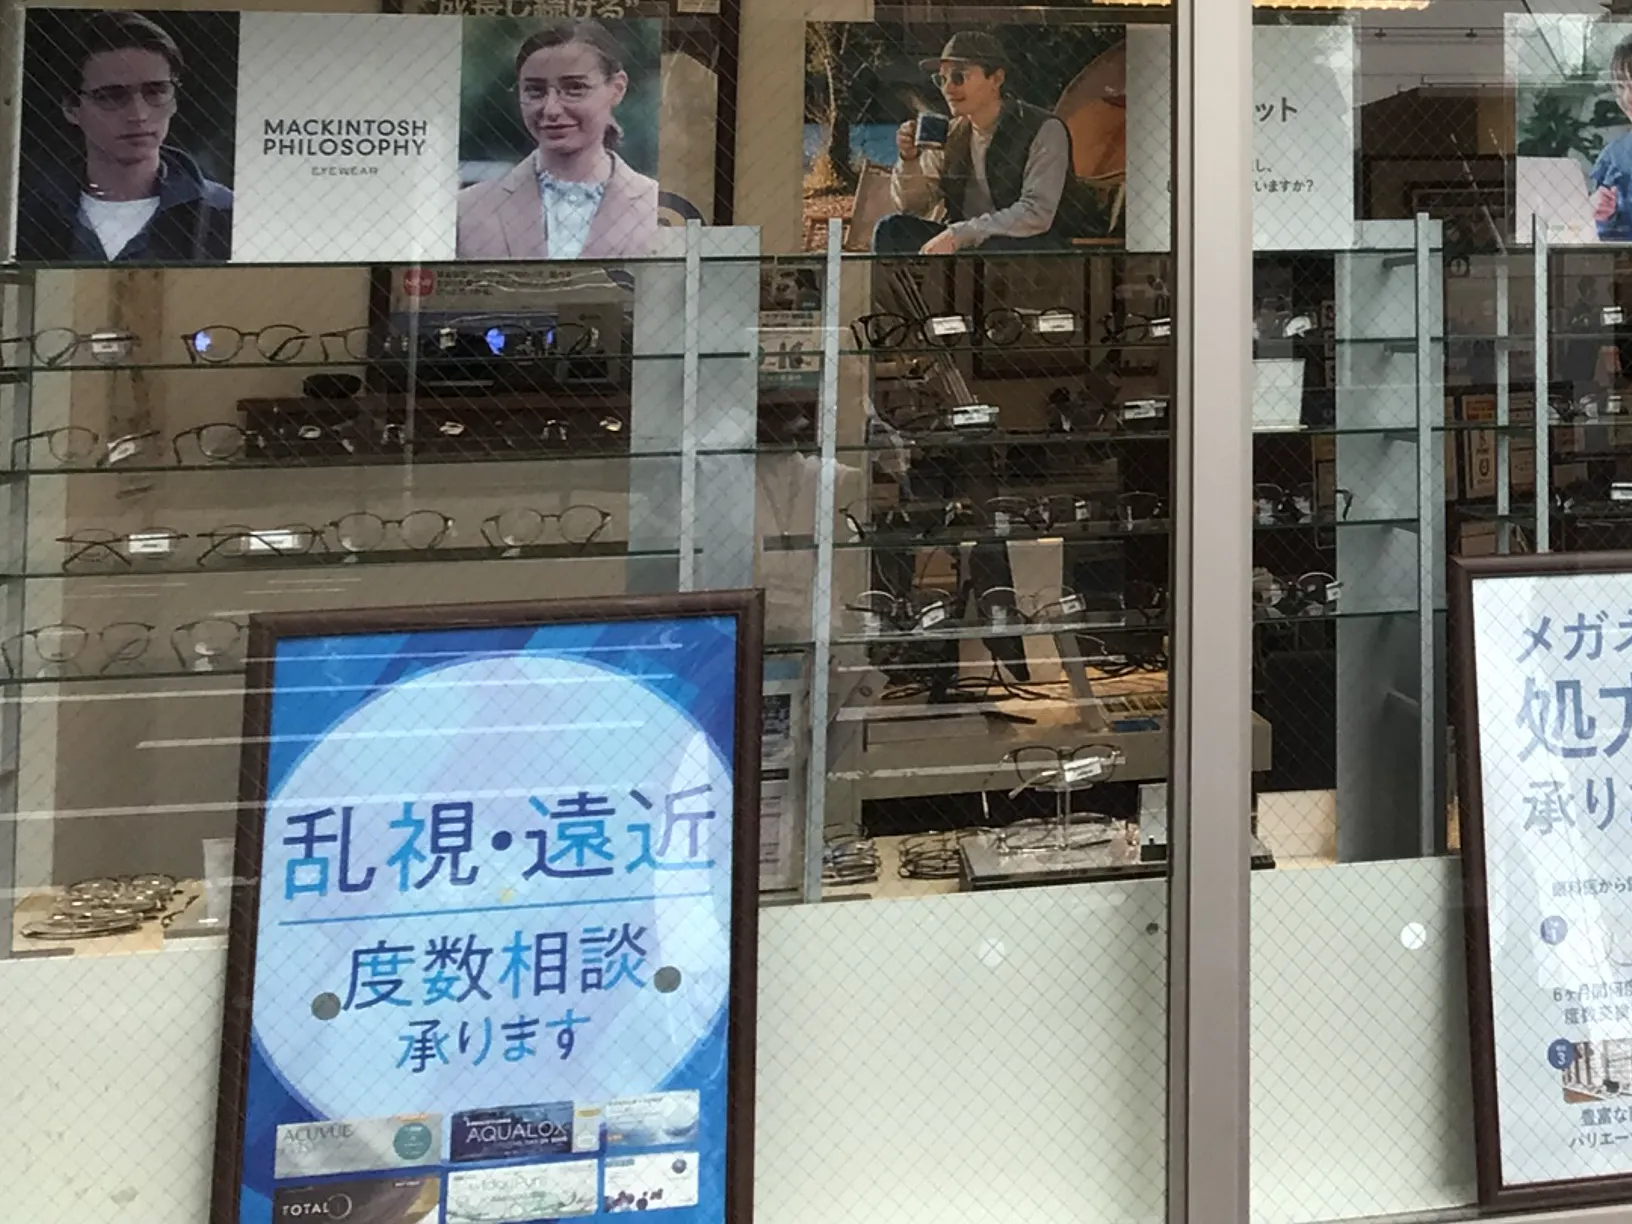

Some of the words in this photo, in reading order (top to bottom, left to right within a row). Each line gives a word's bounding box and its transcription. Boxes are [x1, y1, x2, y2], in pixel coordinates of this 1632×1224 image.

[263, 118, 428, 137] MACKINTOSH
[263, 138, 427, 157] PHILOSOPHY
[311, 165, 379, 177] EYEWEAR
[282, 783, 718, 901] 乱視・遠近
[342, 922, 648, 1012] 度数相談
[396, 1008, 592, 1074] 承ります
[465, 1120, 568, 1144] AQUALOX
[281, 1202, 330, 1217] TOTAL
